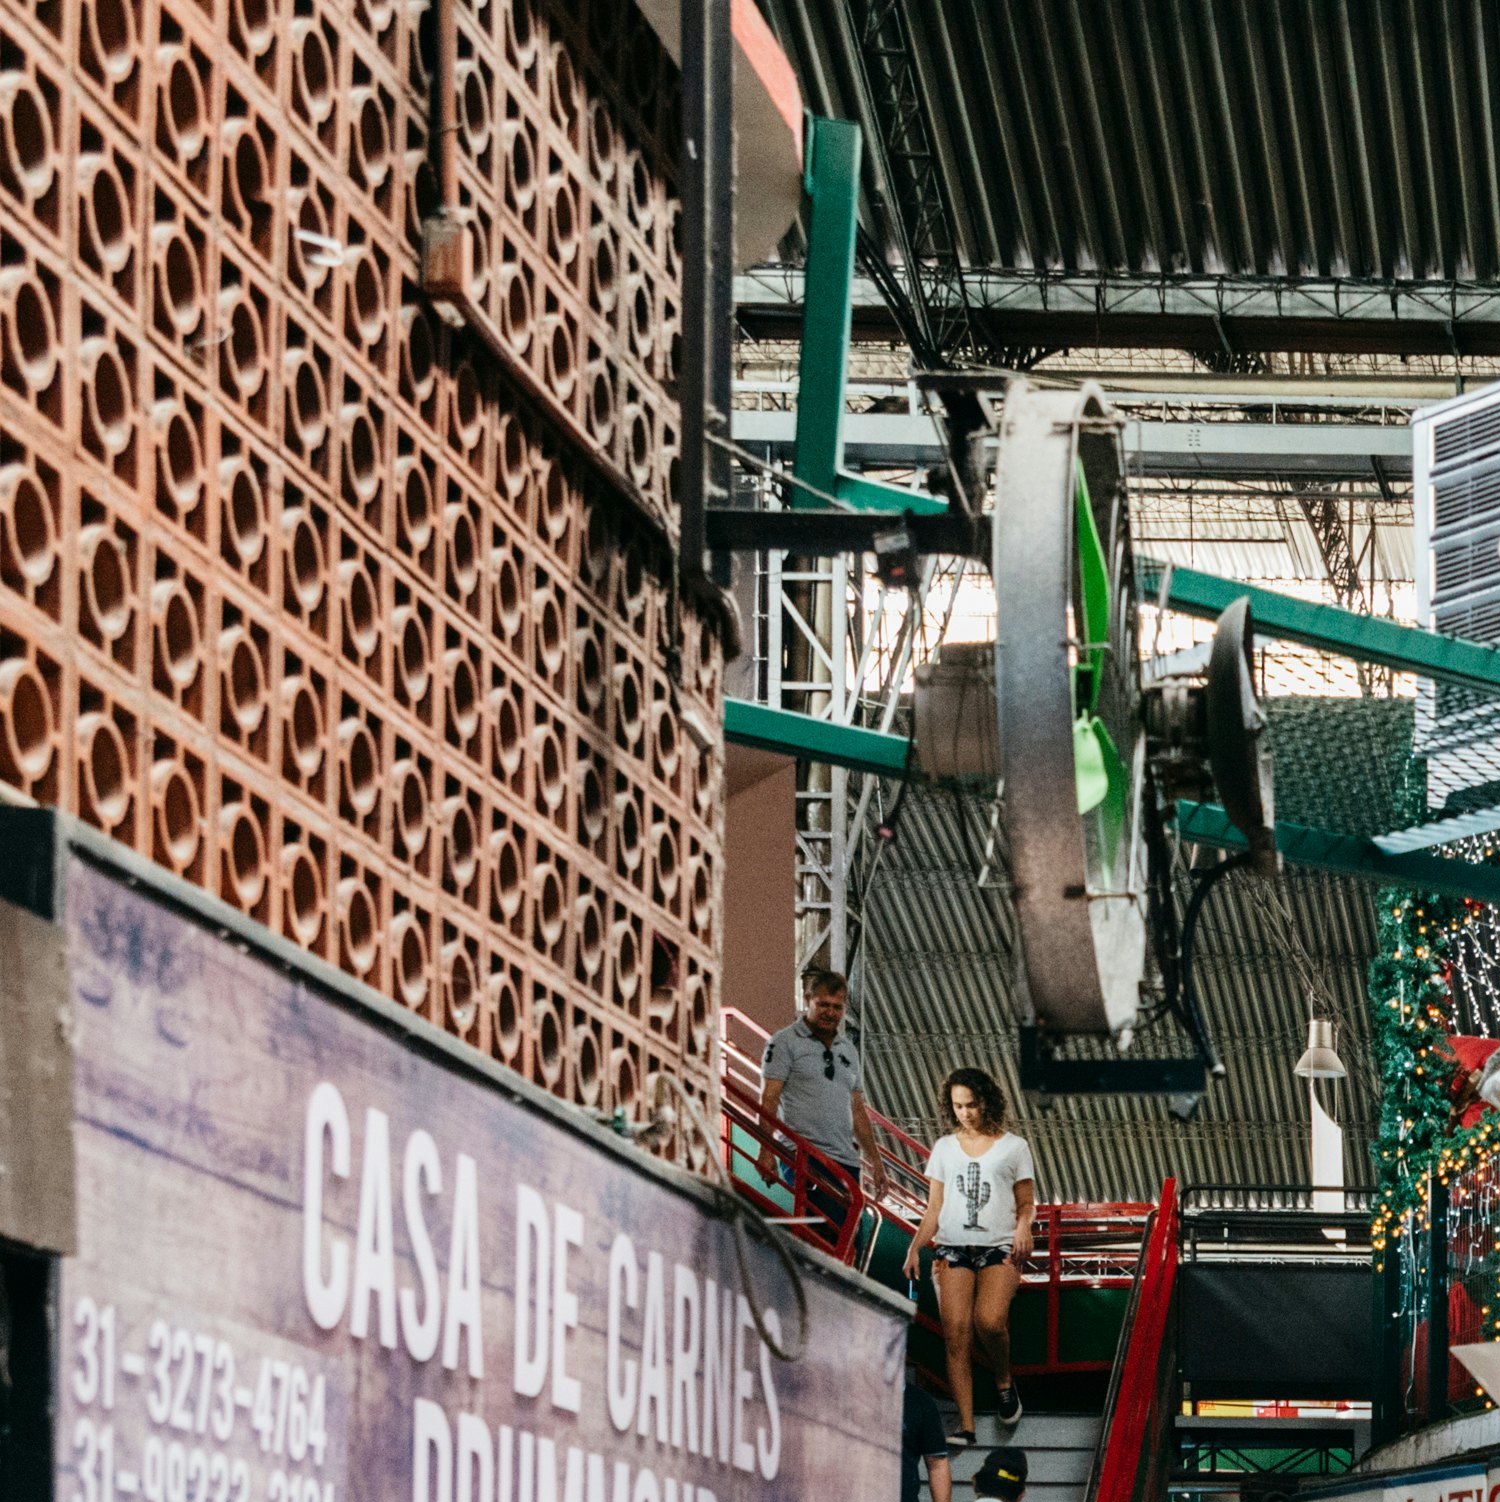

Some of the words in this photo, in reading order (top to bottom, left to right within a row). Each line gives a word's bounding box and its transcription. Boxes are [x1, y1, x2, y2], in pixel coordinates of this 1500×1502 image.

[72, 1297, 328, 1467] 31-3273-4764
[302, 1081, 484, 1380] CASA
[515, 1183, 584, 1412] DE
[606, 1231, 783, 1481] CARNES
